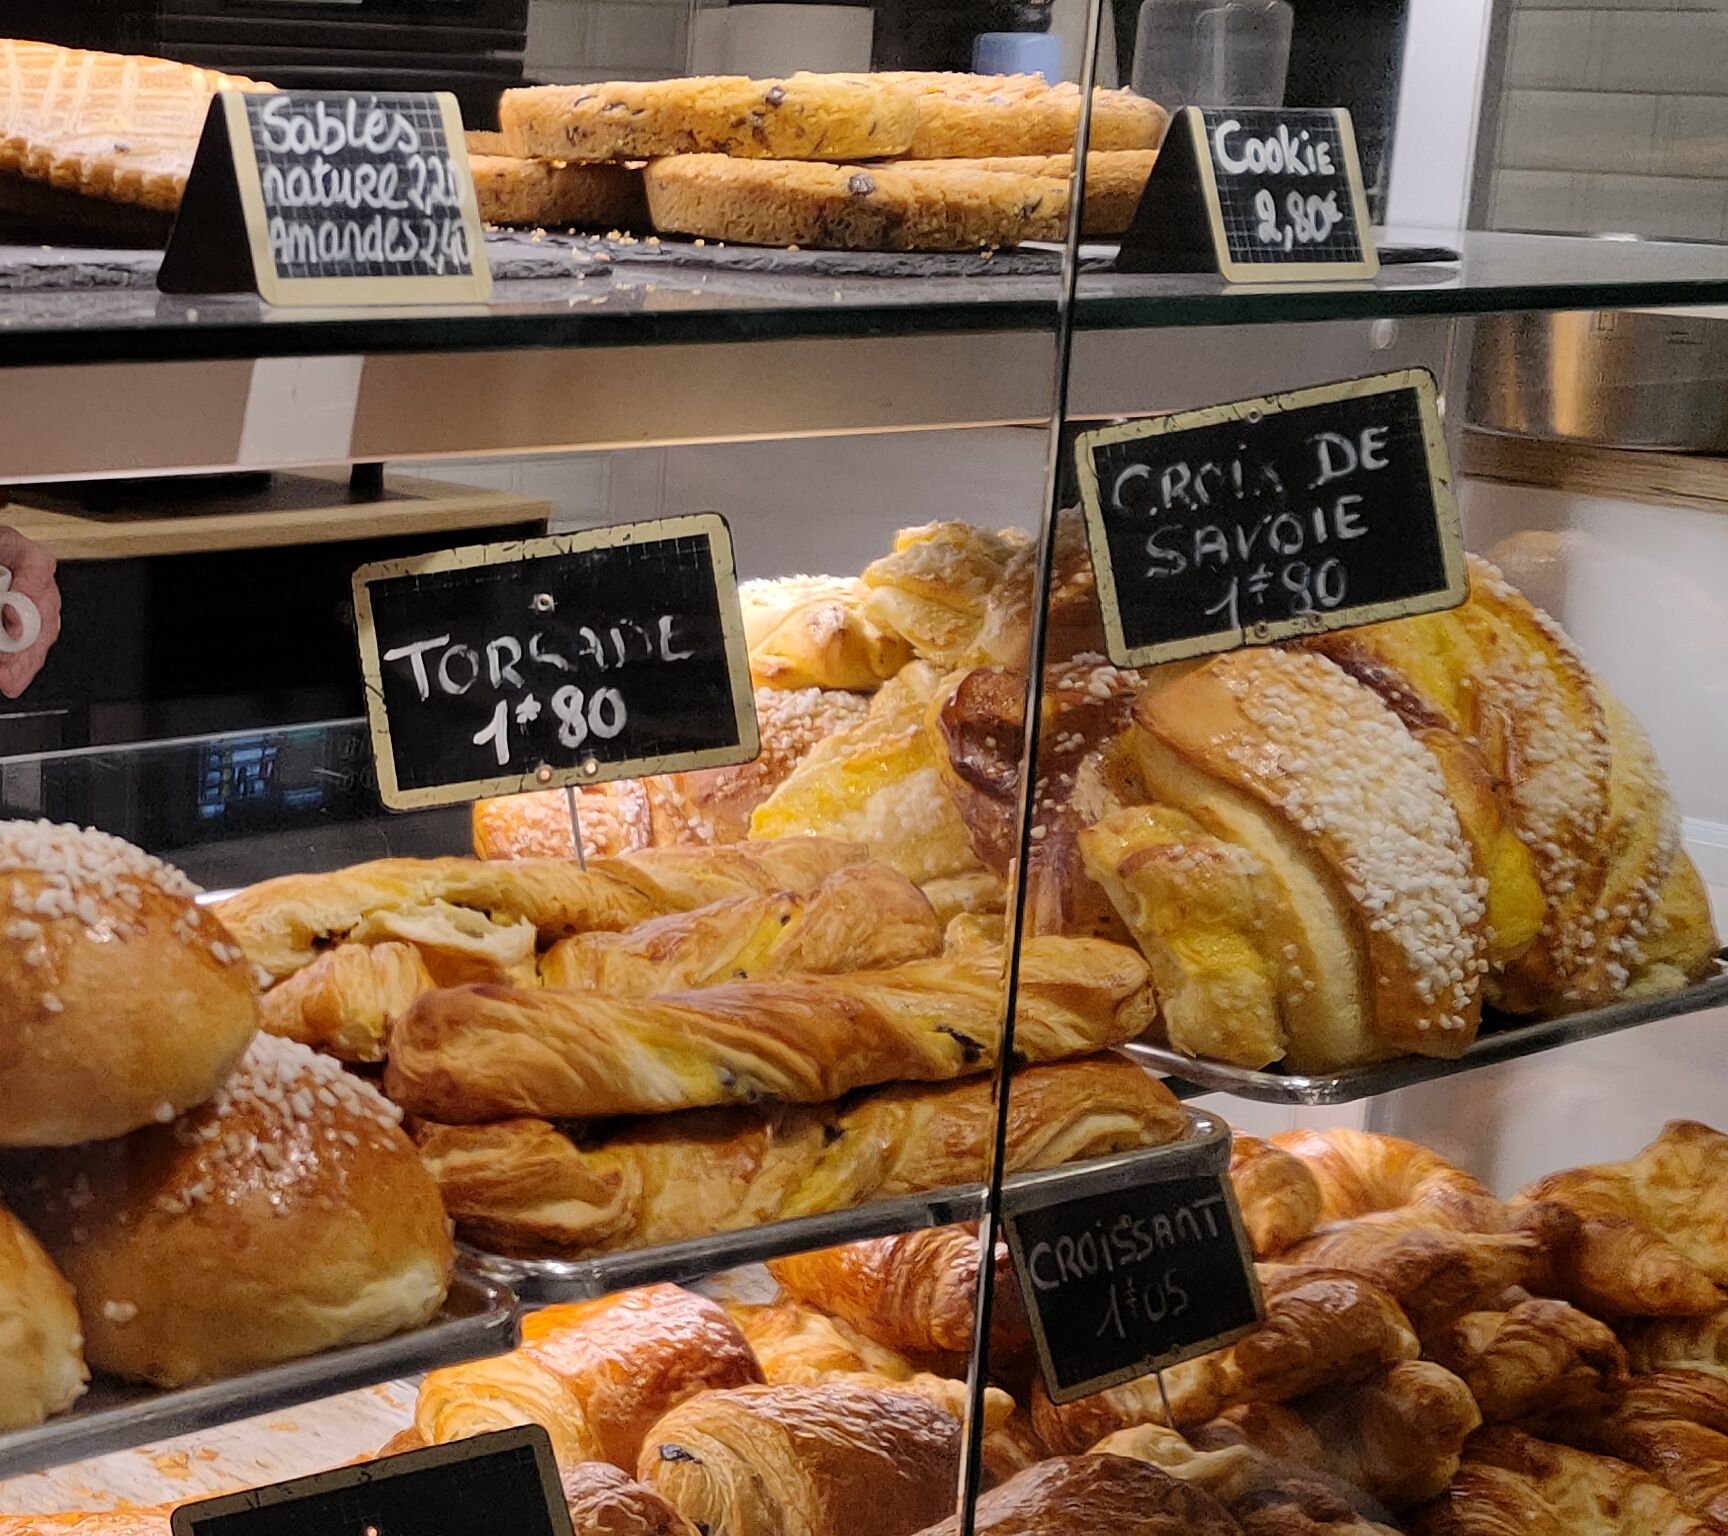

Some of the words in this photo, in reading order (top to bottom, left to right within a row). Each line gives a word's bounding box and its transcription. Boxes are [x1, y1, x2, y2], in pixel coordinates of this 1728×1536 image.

[261, 95, 420, 156] Sablés
[262, 155, 409, 210] nature
[269, 214, 419, 264] Amandes
[1254, 188, 1344, 253] 2,80€
[1305, 425, 1391, 490] DE
[1144, 493, 1370, 579] SAVOIE
[1029, 1195, 1224, 1291] CROISSANT
